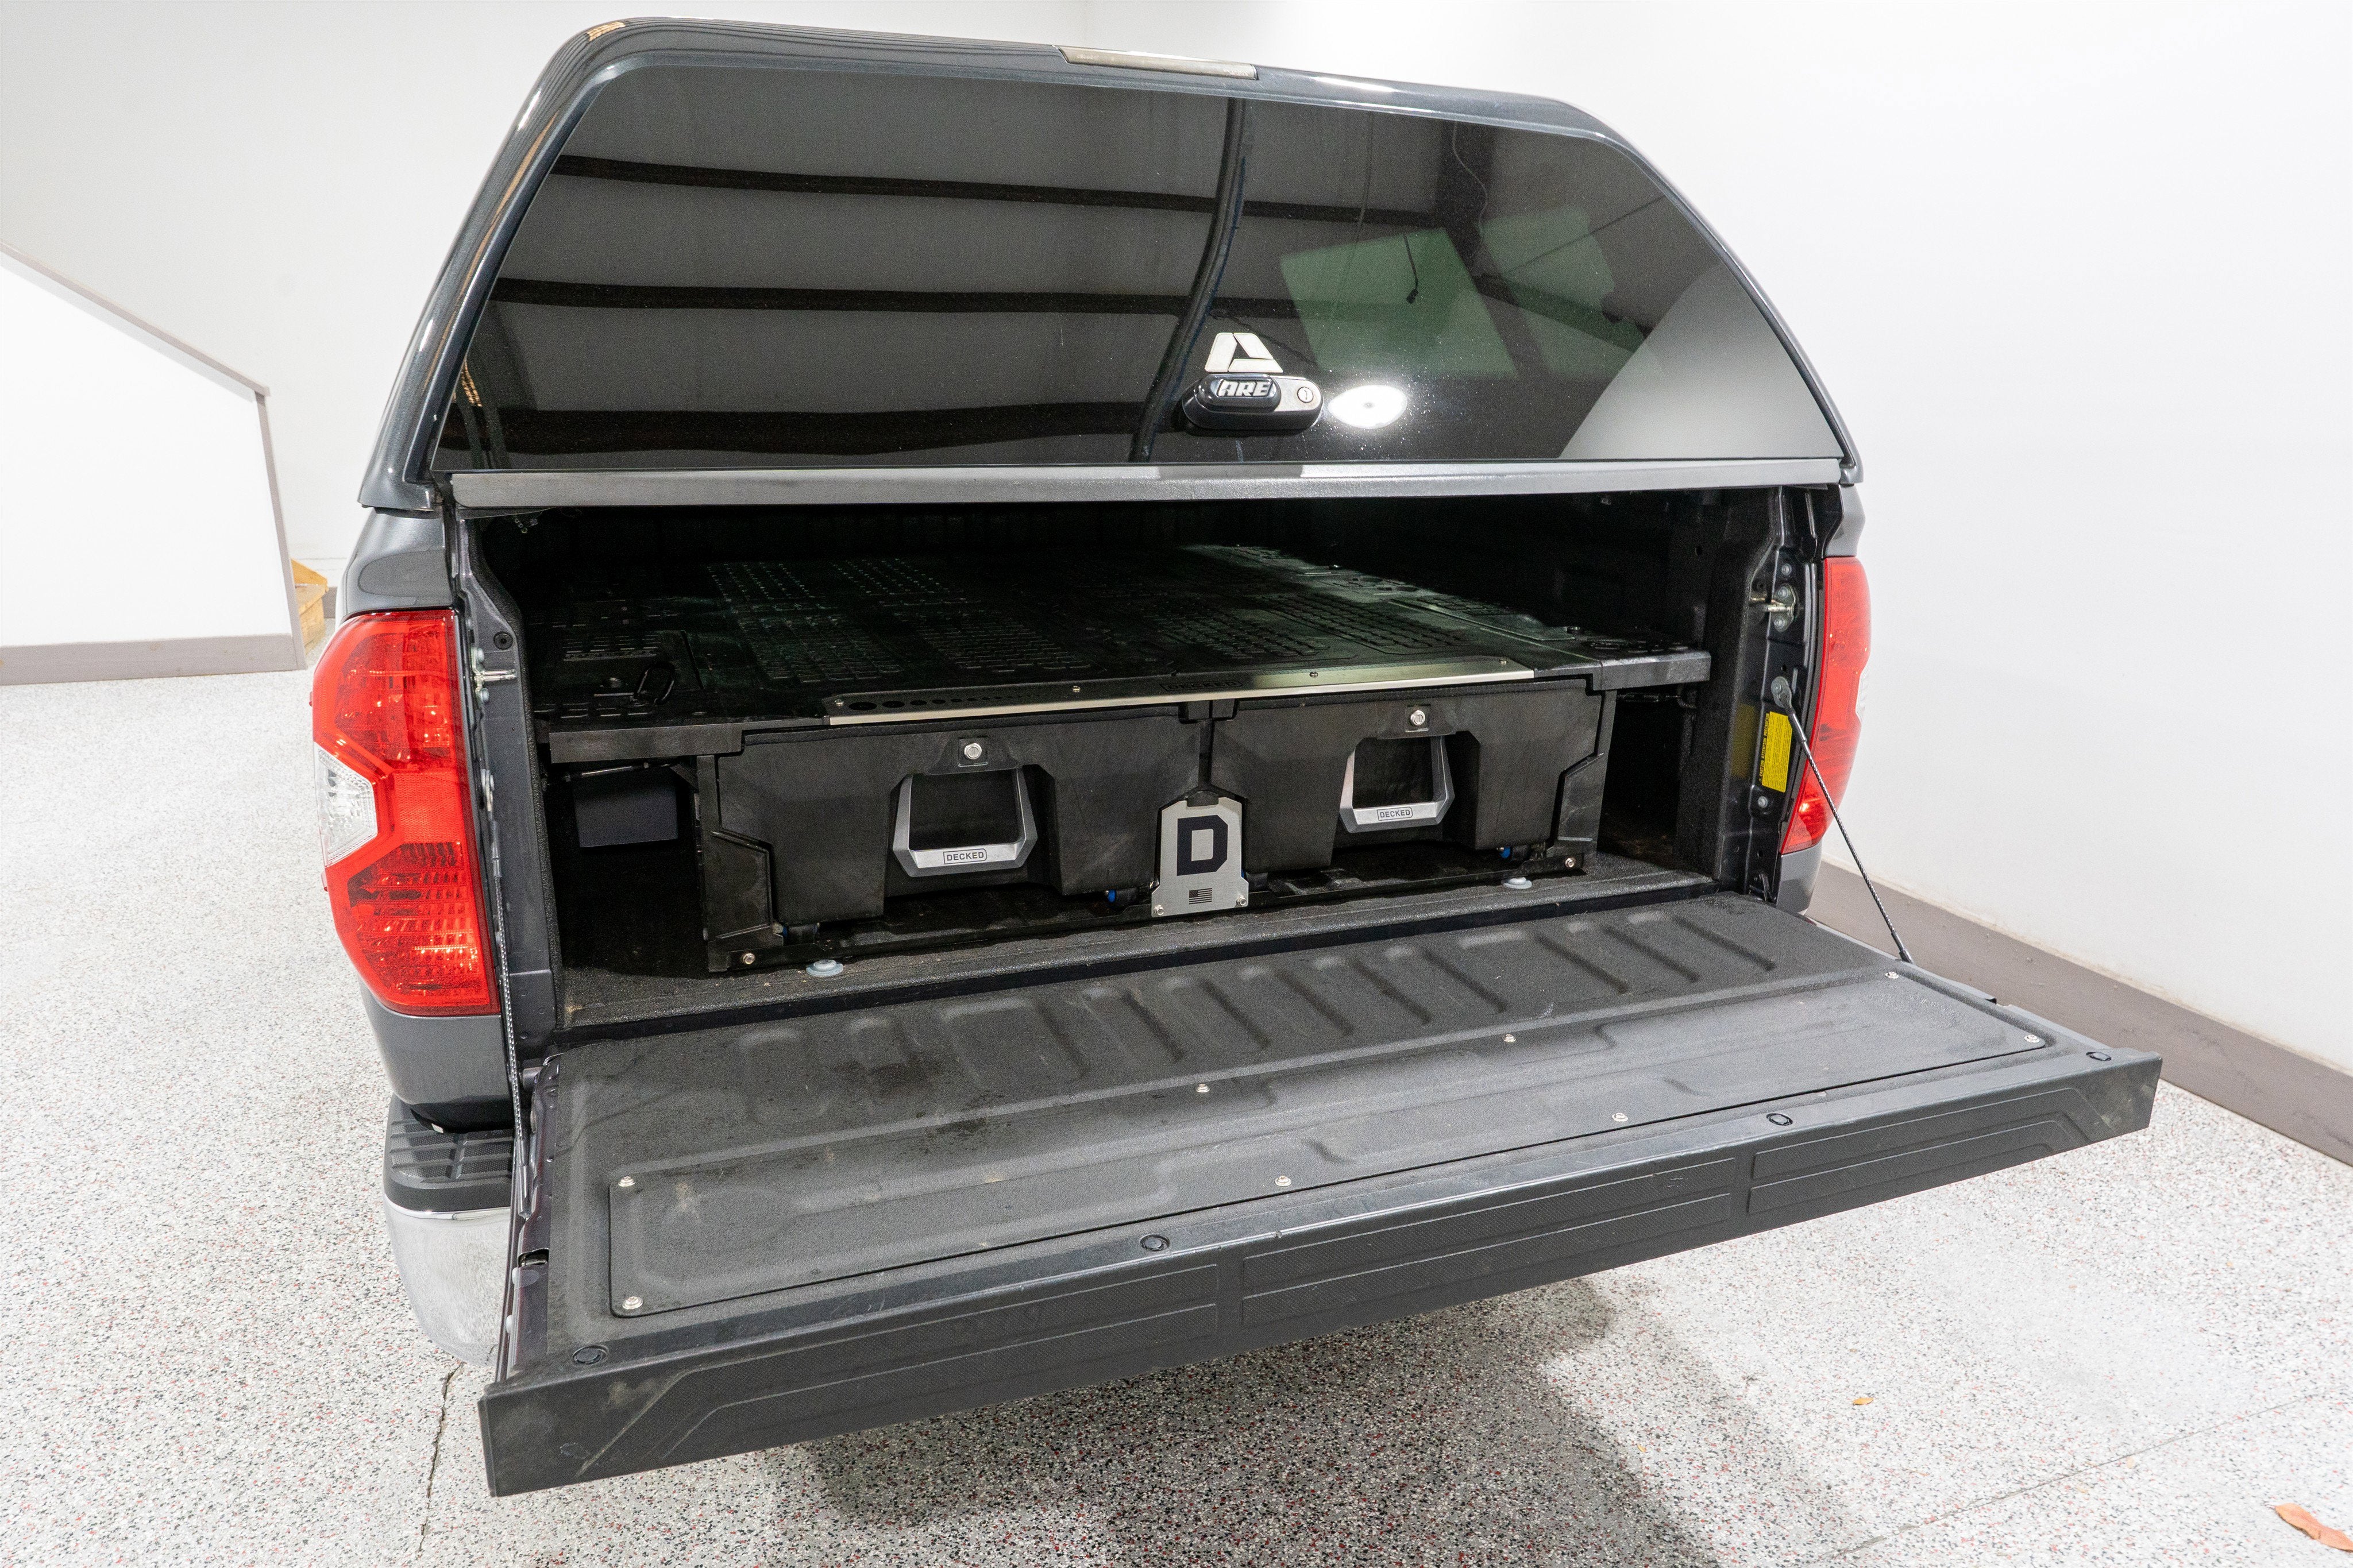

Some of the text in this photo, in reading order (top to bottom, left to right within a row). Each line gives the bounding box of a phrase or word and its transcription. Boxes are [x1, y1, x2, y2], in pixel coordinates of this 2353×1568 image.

[1218, 380, 1272, 396] ARE
[1380, 809, 1410, 818] DECKED
[1176, 814, 1228, 876] D
[947, 851, 984, 861] DECKED
